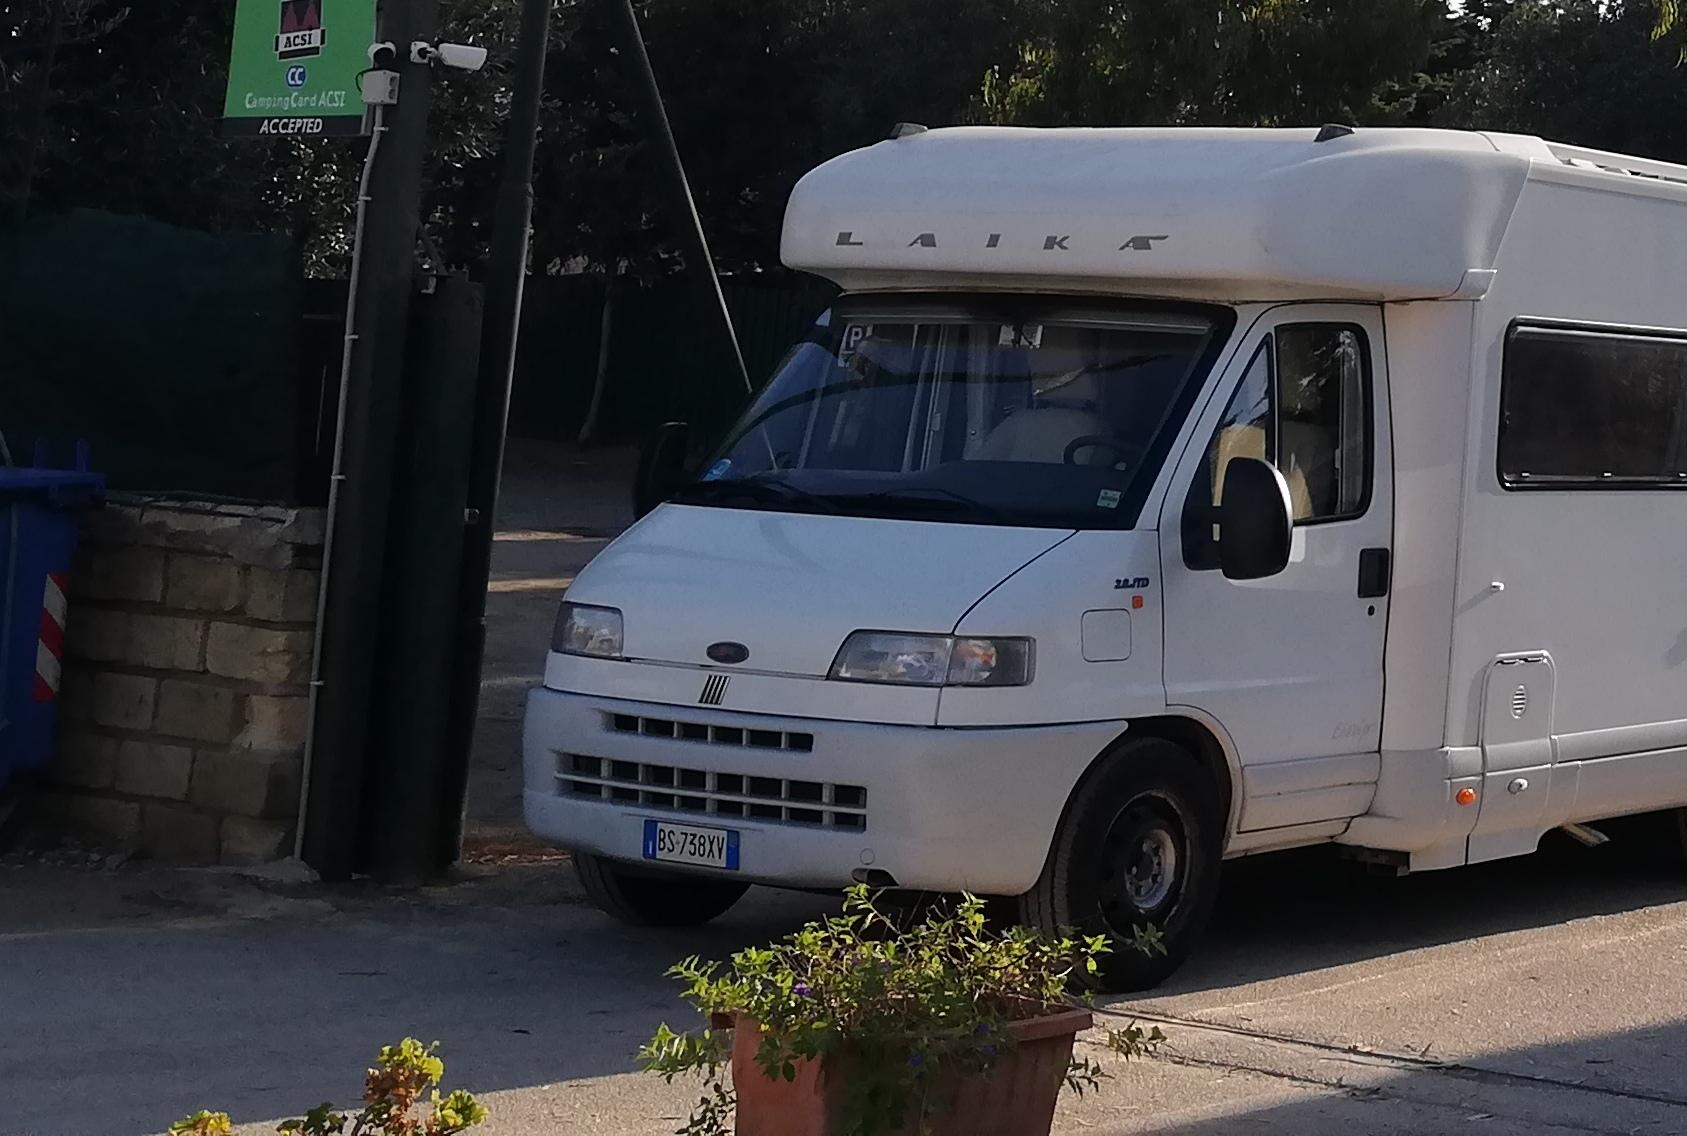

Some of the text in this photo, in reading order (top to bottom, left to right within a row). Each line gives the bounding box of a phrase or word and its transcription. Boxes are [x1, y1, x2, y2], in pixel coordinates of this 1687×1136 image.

[284, 32, 314, 48] ACSI
[287, 67, 304, 85] CC
[318, 90, 346, 108] ACSI
[259, 118, 323, 134] ACCEPTED
[835, 231, 1169, 251] LAIKA
